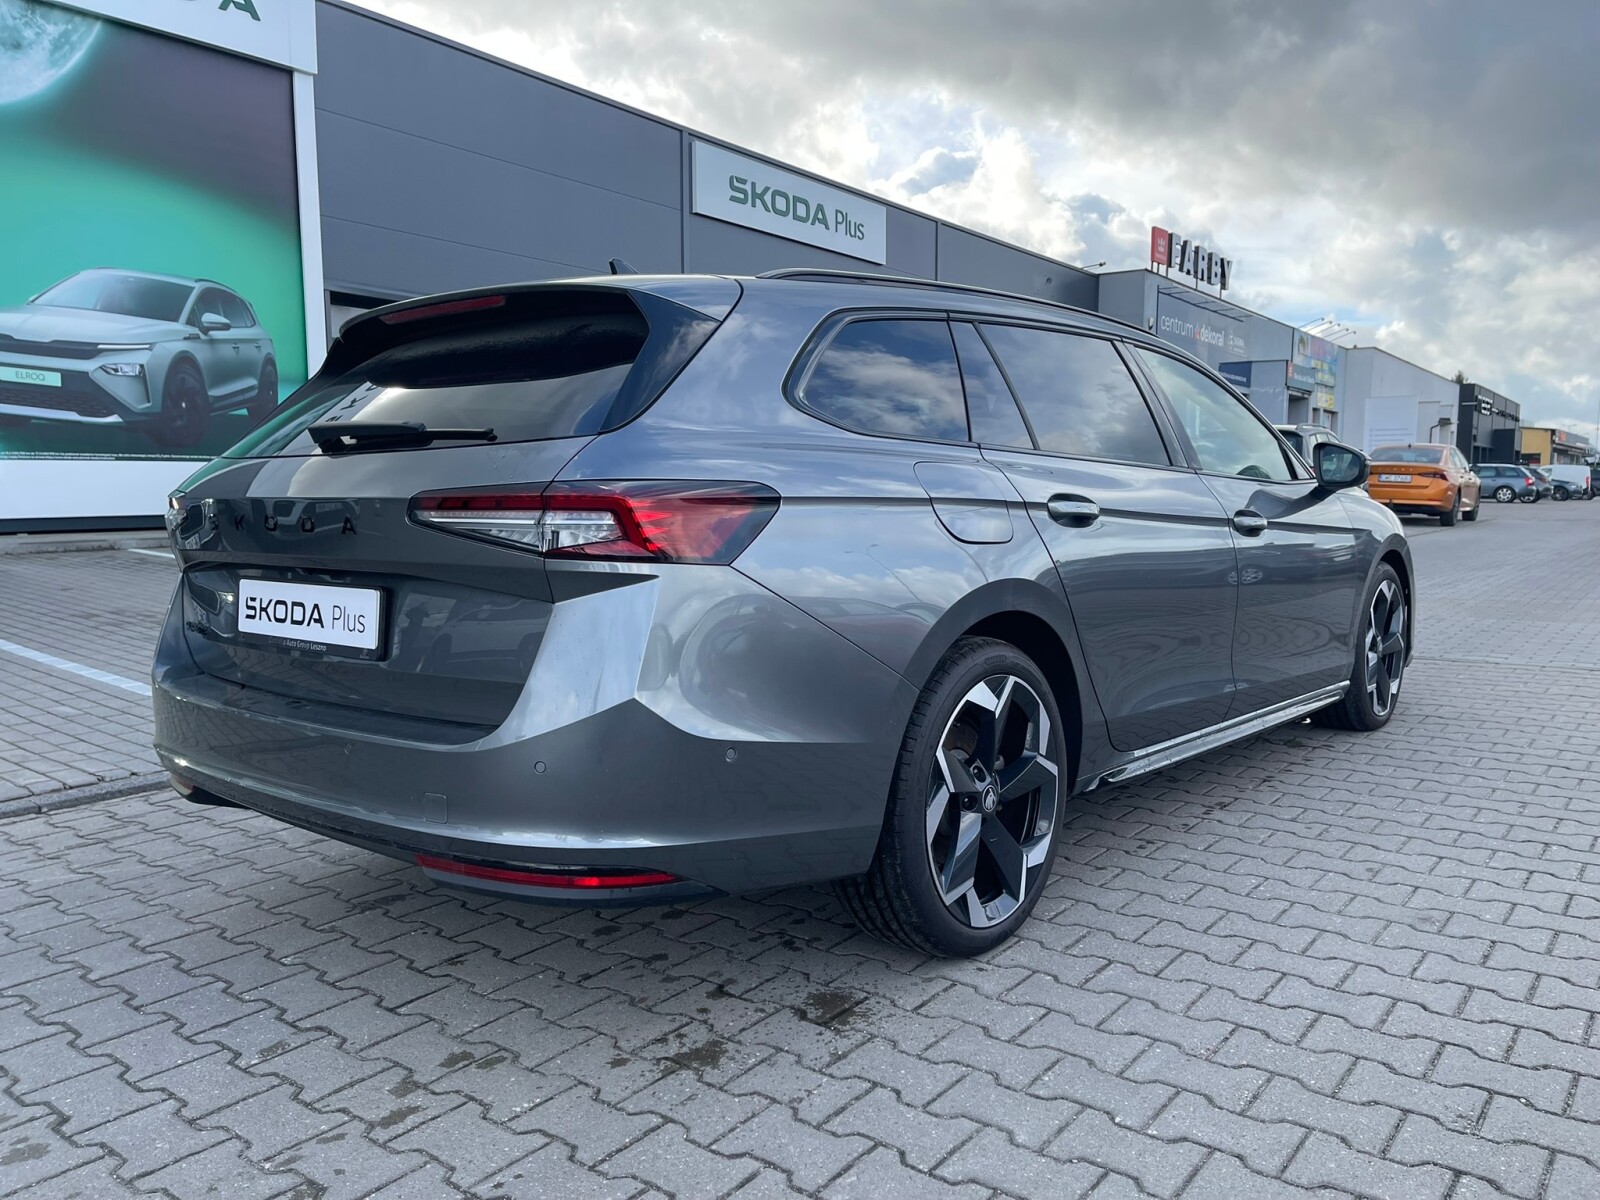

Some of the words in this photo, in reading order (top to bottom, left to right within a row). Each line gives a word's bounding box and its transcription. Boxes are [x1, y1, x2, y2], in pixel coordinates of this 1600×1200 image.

[728, 174, 830, 231] SKODA
[834, 208, 865, 241] Plus
[1168, 232, 1233, 290] FARBY
[1160, 315, 1194, 338] centrum
[1200, 324, 1225, 347] dekoral
[15, 371, 46, 381] ELROQ
[245, 597, 325, 628] SKODA
[331, 605, 366, 634] Plus
